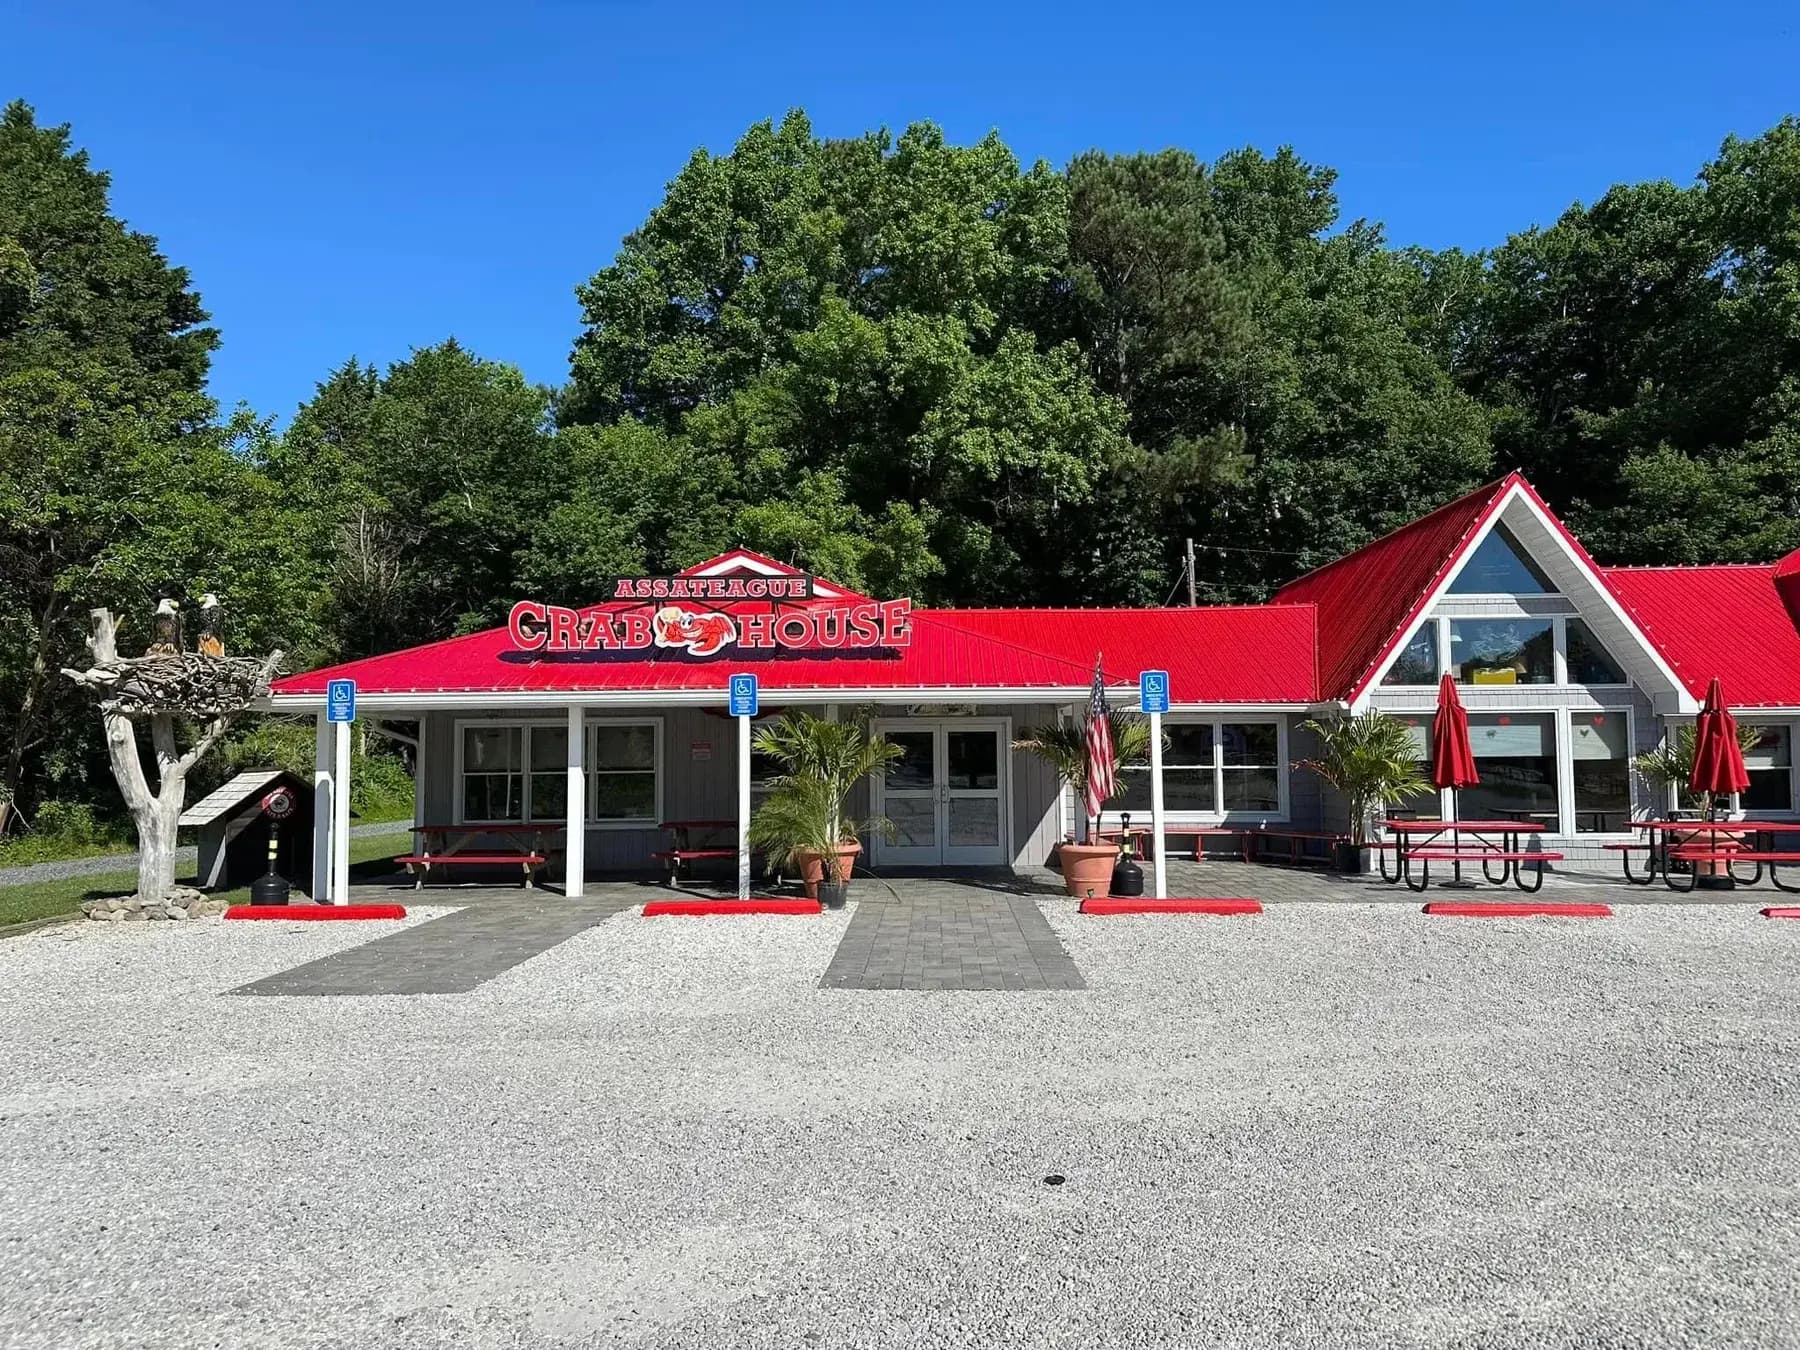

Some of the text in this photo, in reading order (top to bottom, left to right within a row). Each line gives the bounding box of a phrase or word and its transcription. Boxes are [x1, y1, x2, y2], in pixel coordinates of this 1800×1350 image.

[615, 579, 808, 598] ASSATEAGUE
[507, 597, 912, 651] CRAB HOUSE
